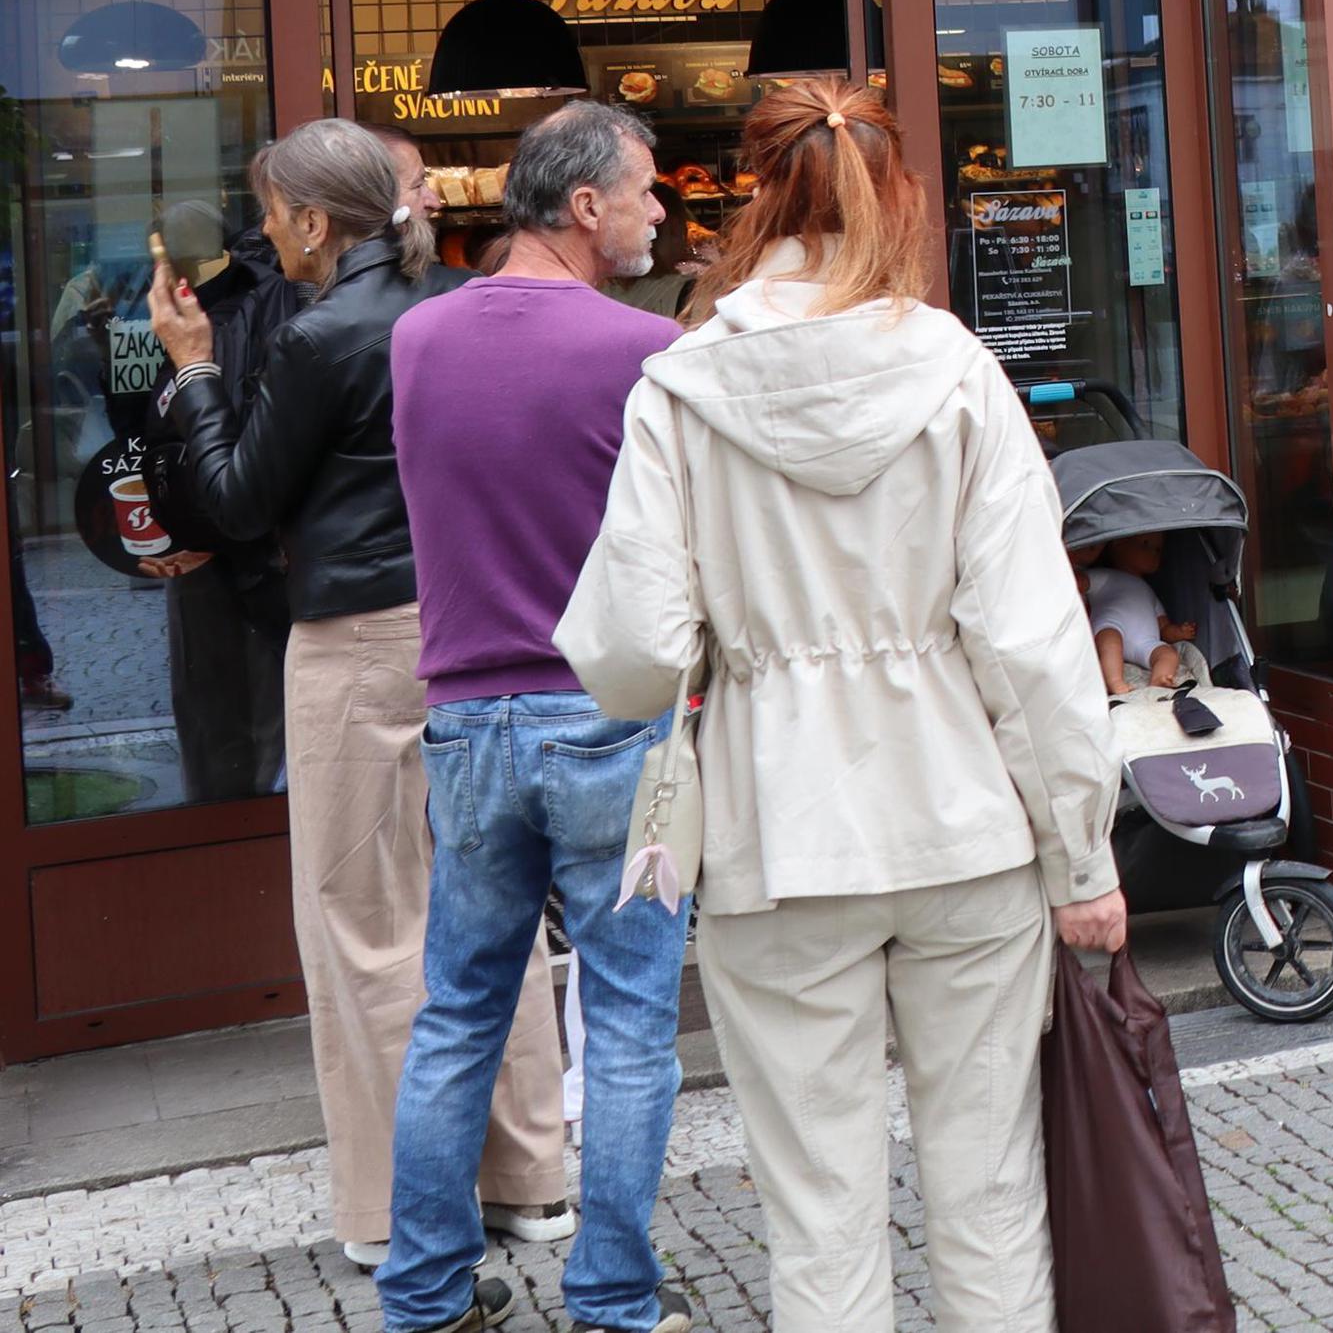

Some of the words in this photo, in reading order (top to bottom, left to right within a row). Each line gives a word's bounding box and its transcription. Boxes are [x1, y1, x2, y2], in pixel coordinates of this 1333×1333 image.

[1031, 46, 1081, 58] SOBOTA
[1024, 67, 1065, 78] OTVÍRACÍ
[1067, 67, 1089, 76] DOBA
[1020, 95, 1056, 108] 7:30
[1079, 93, 1096, 106] 11
[967, 199, 1060, 223] Sázava
[1010, 236, 1030, 244] 6:30
[1036, 234, 1060, 243] 18:00
[988, 247, 999, 255] So
[1011, 245, 1030, 254] 7:30
[114, 327, 168, 360] ZÁKA
[114, 363, 161, 392] KOU
[102, 453, 142, 475] SÁZ
